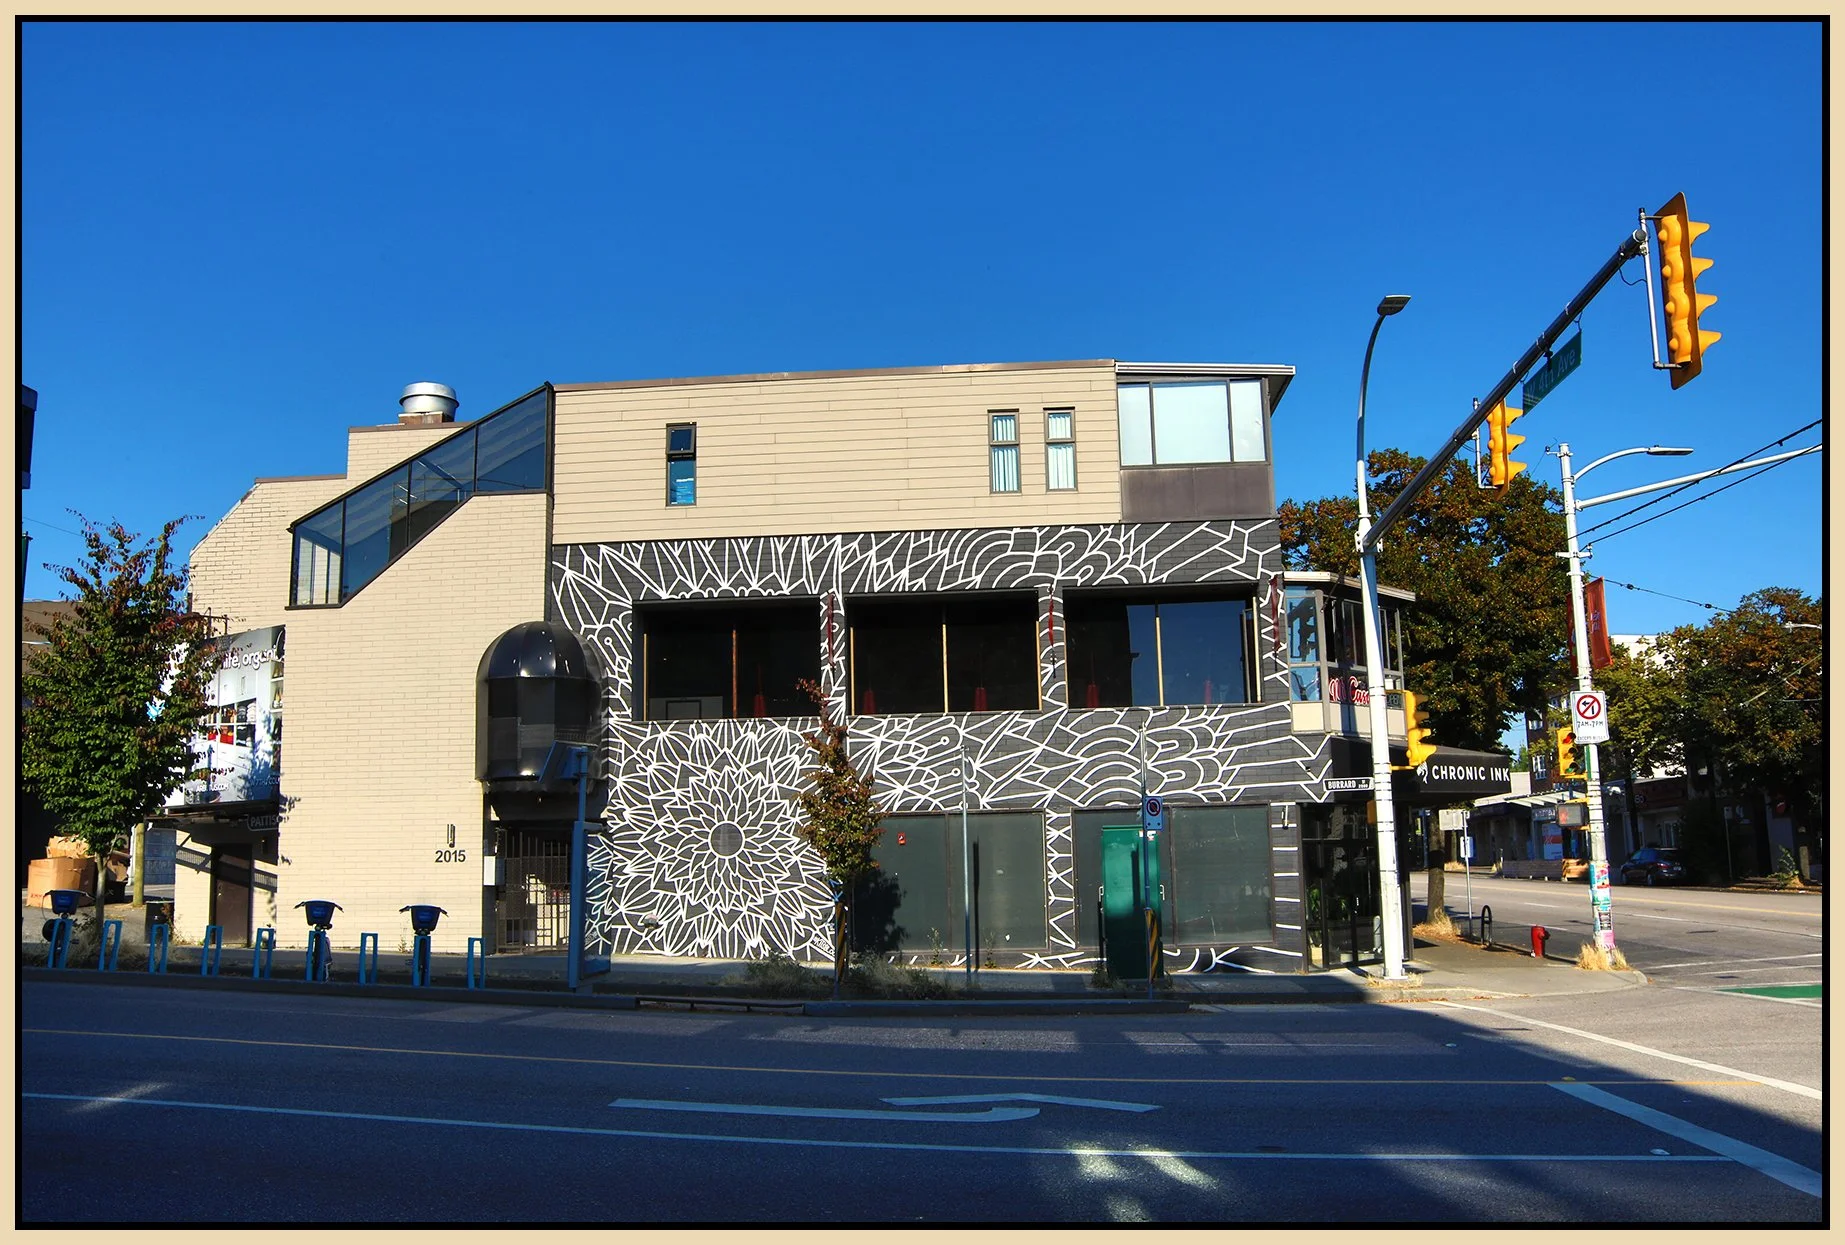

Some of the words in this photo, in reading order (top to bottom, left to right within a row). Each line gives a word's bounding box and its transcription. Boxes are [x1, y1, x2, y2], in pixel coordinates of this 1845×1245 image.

[1539, 369, 1554, 390] 4th
[1558, 350, 1576, 377] Ave
[1432, 765, 1485, 781] CHRONIC
[1490, 767, 1510, 781] INK
[1328, 780, 1356, 789] BURRARD
[435, 850, 466, 863] 2015
